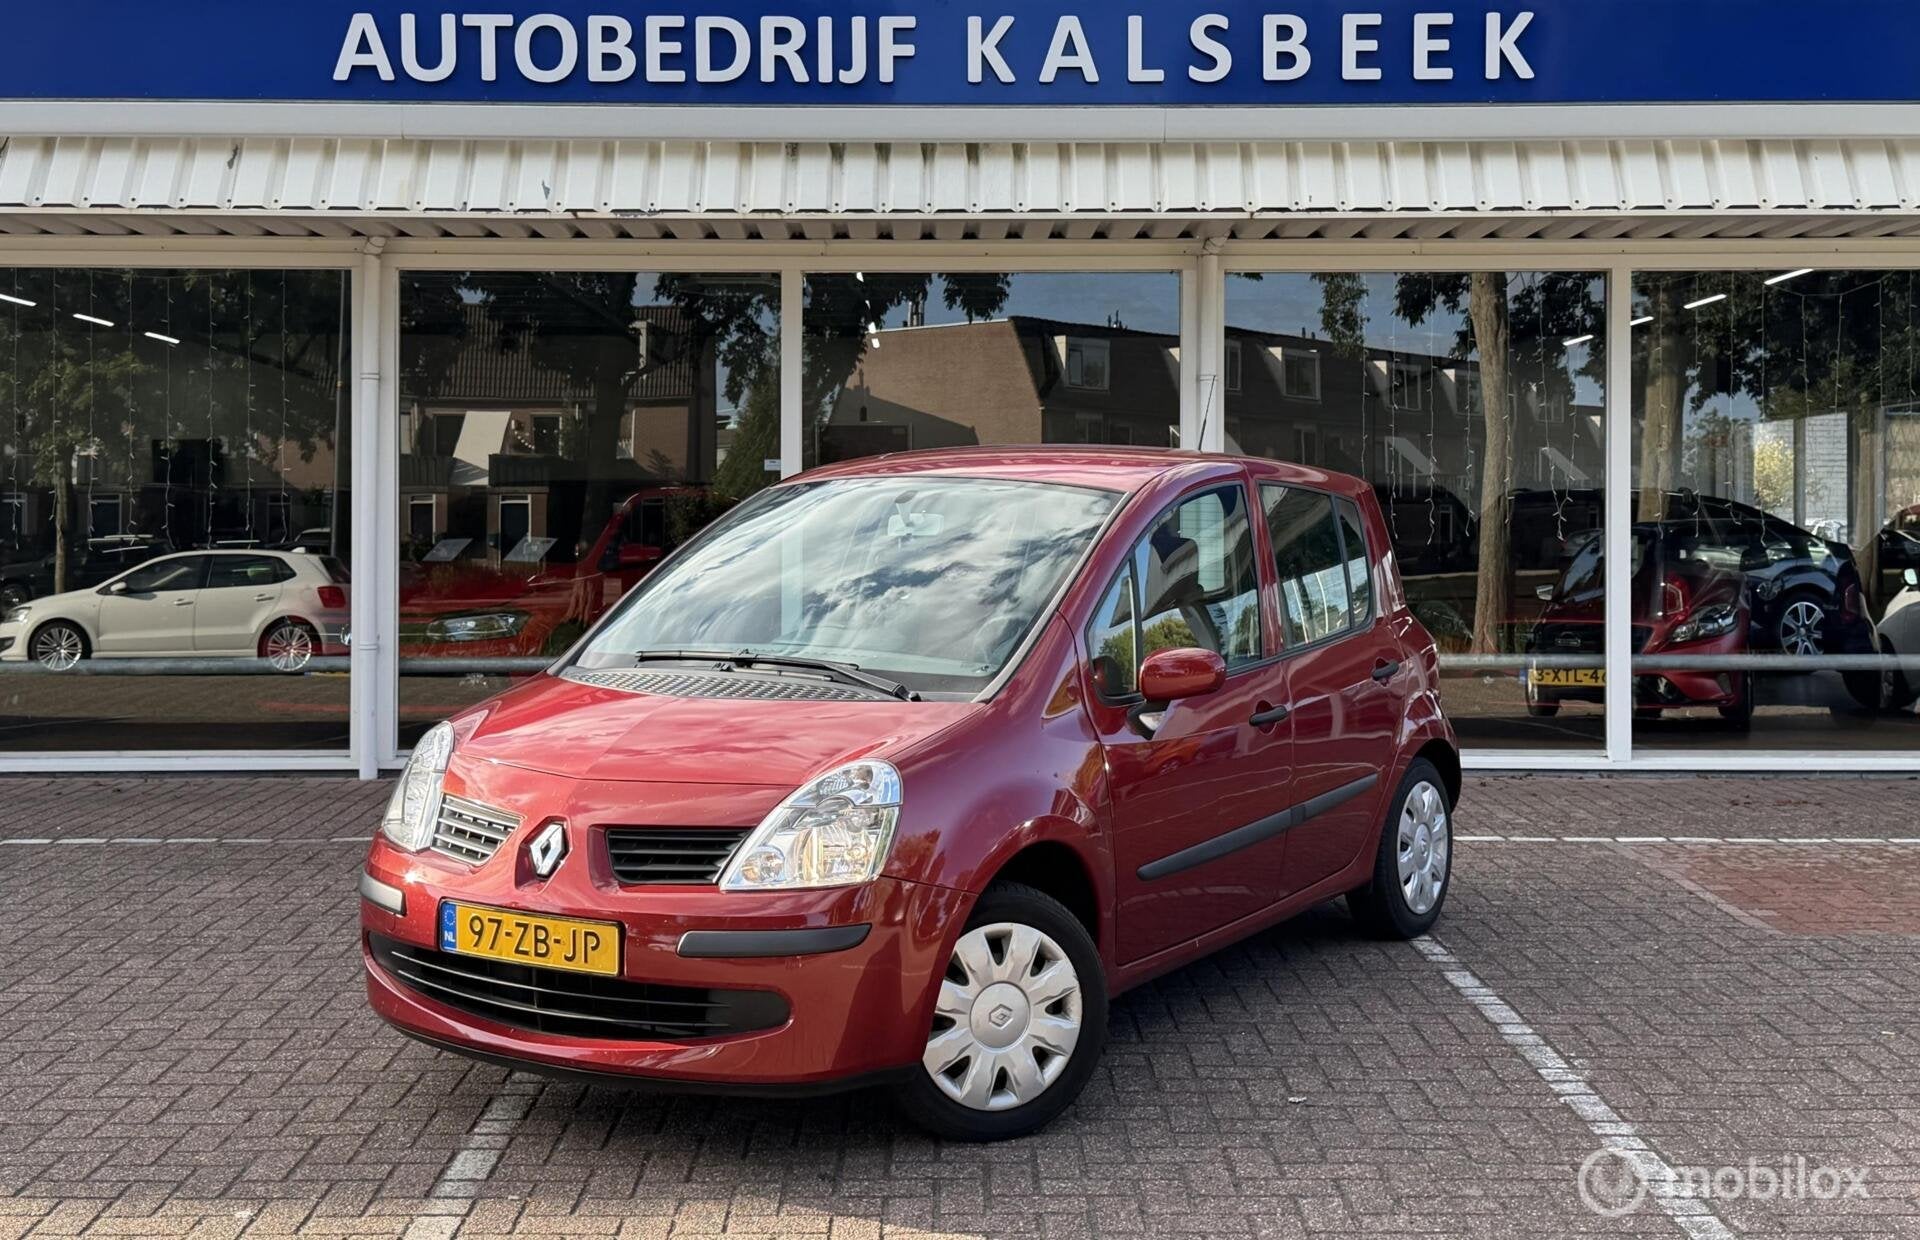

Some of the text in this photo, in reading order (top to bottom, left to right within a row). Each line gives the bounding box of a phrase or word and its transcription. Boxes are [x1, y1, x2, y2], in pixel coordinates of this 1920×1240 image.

[333, 12, 1536, 83] AUTOBEDRIJF KALSBEEK
[444, 931, 456, 943] NL
[468, 914, 601, 964] 97-ZB-JP
